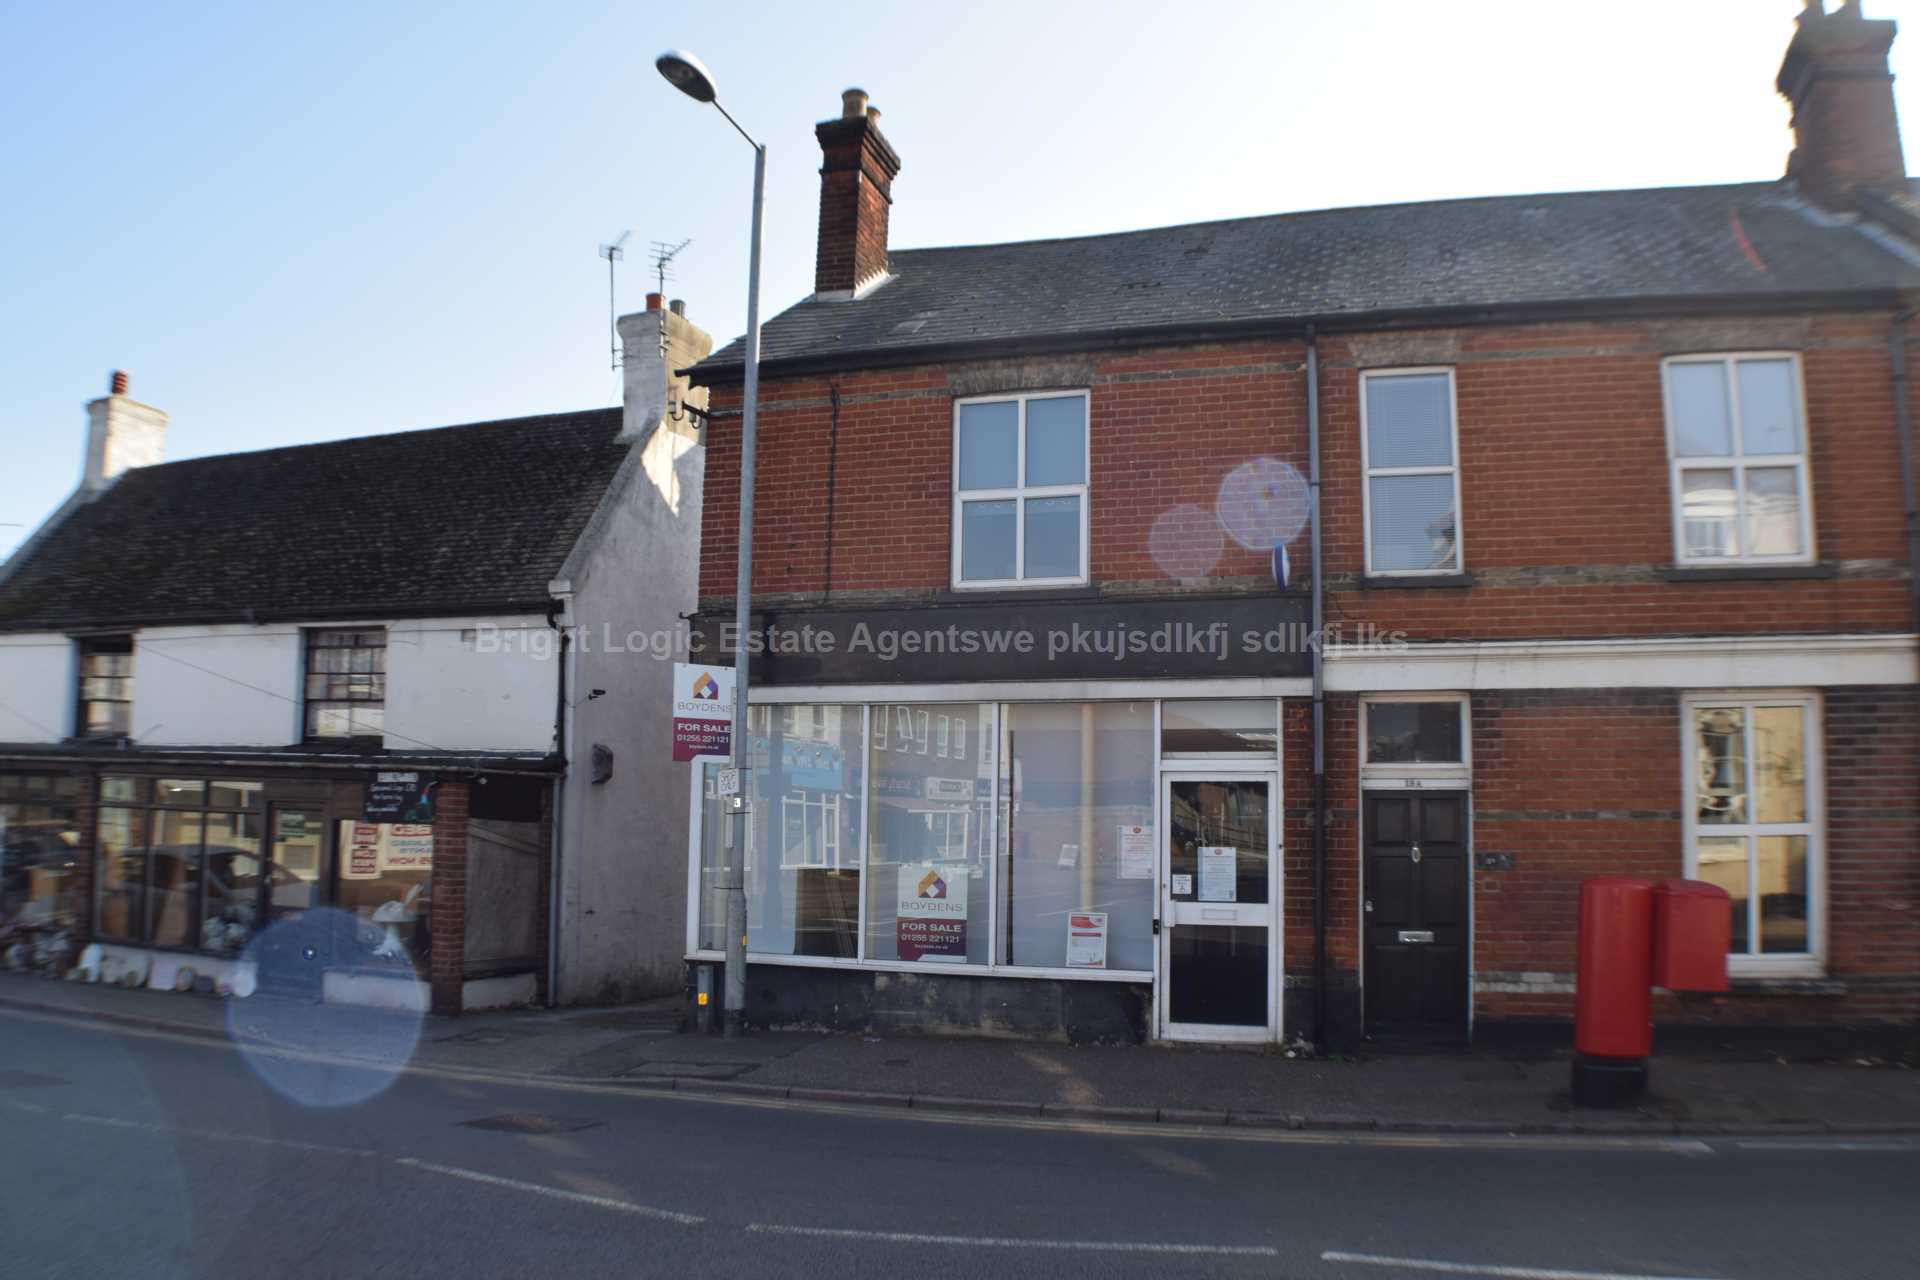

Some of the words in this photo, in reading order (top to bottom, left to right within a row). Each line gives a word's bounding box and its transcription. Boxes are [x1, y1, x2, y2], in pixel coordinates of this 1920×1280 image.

[677, 701, 733, 713] BOYDENS
[678, 722, 701, 732] FOR
[703, 723, 731, 734] SALE
[703, 735, 729, 744] 221121
[901, 901, 963, 913] BOYDENS
[902, 922, 927, 932] FOR
[929, 923, 961, 933] SALE
[929, 934, 960, 944] 221121
